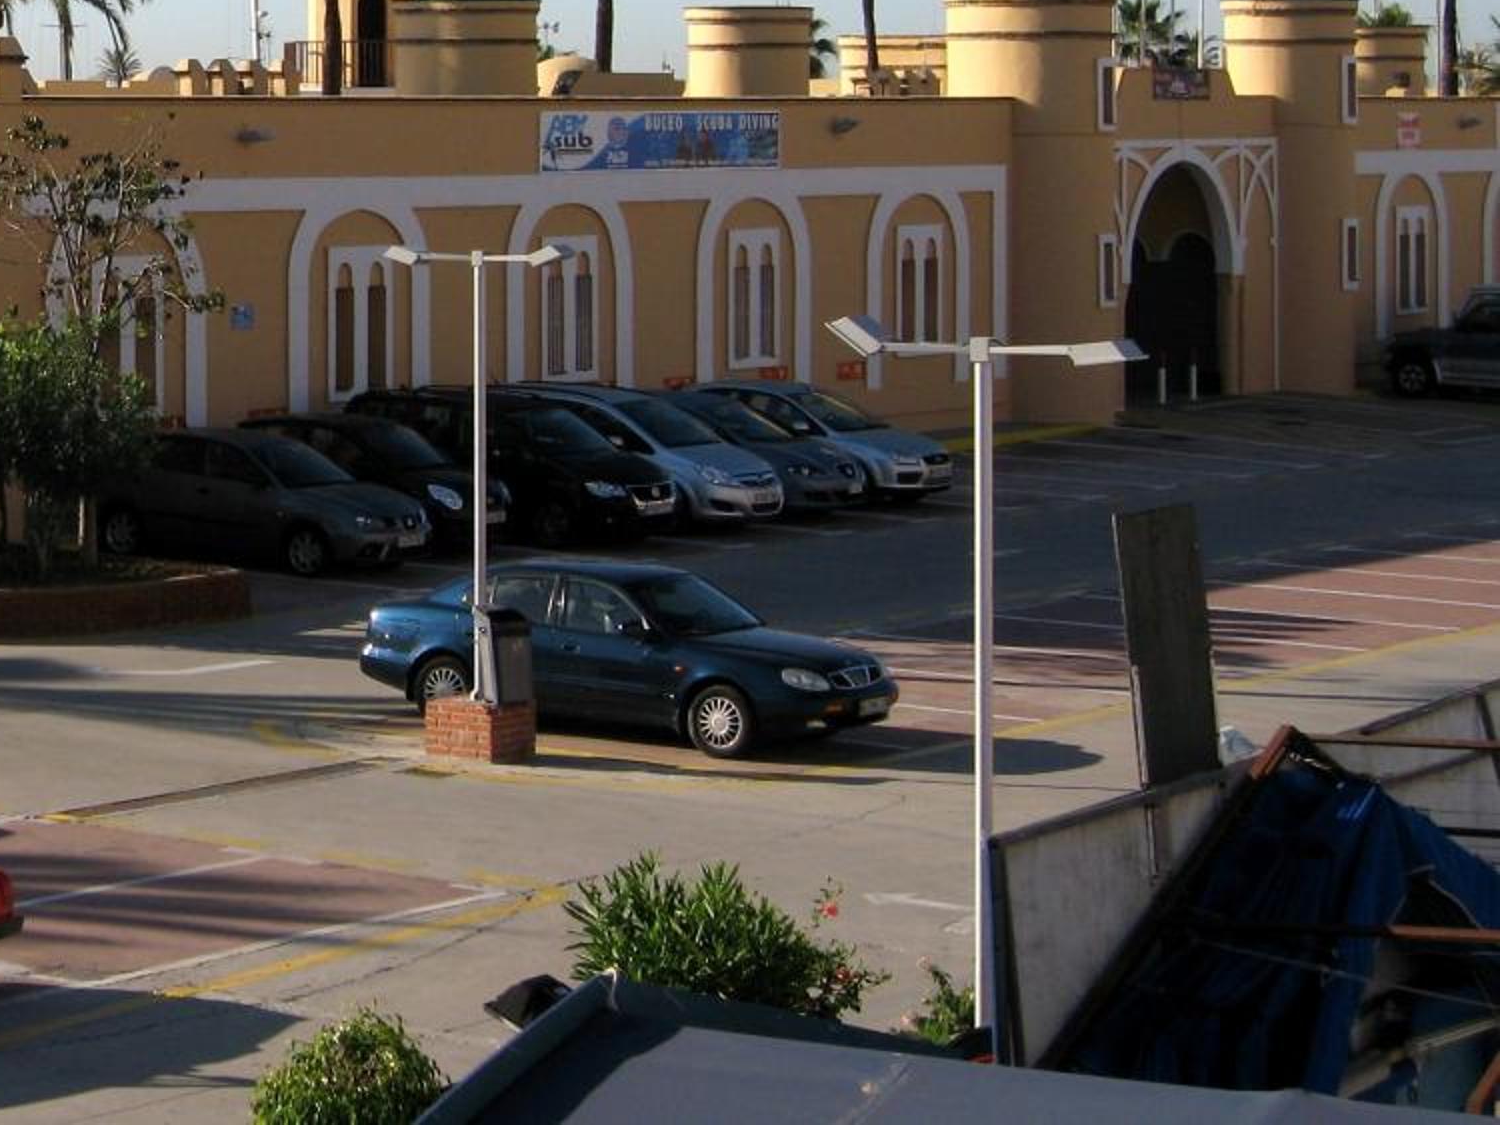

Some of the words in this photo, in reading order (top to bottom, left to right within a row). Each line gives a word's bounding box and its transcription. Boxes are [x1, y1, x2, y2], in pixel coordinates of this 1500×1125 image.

[644, 114, 683, 131] BUCEO
[739, 114, 779, 131] DIVING
[553, 132, 593, 148] sub
